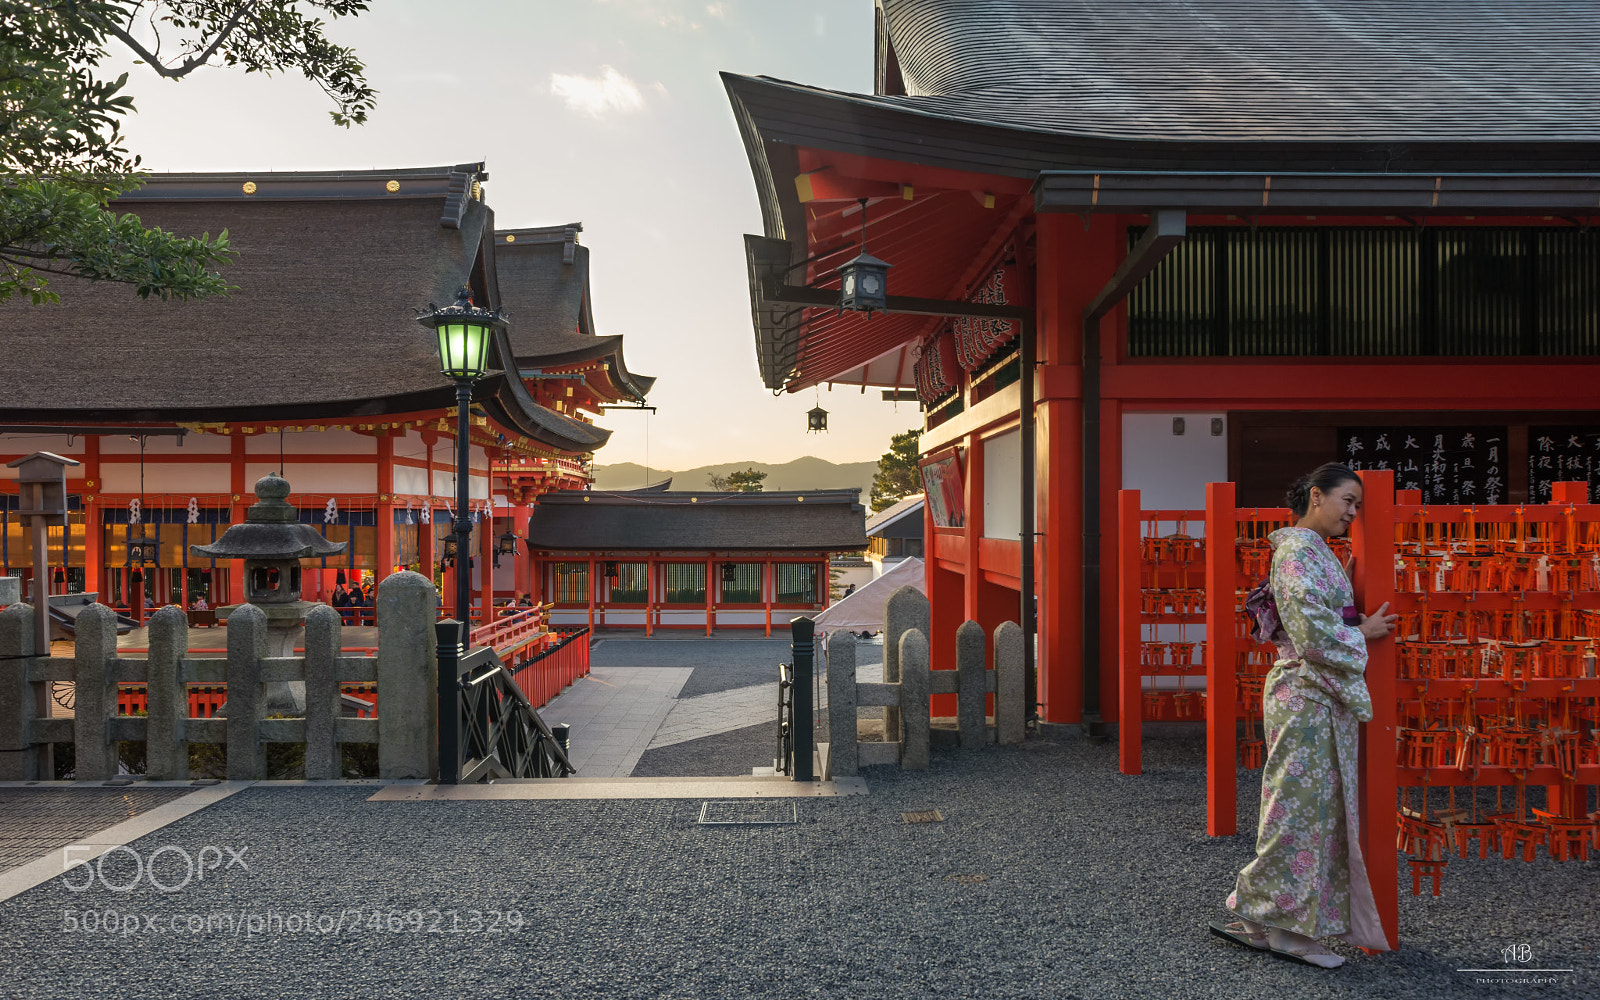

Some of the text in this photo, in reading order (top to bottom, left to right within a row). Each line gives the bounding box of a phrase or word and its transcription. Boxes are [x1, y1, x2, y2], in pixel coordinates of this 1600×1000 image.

[1460, 432, 1476, 496] 歳旦祭
[1536, 436, 1555, 496] 除夜祭
